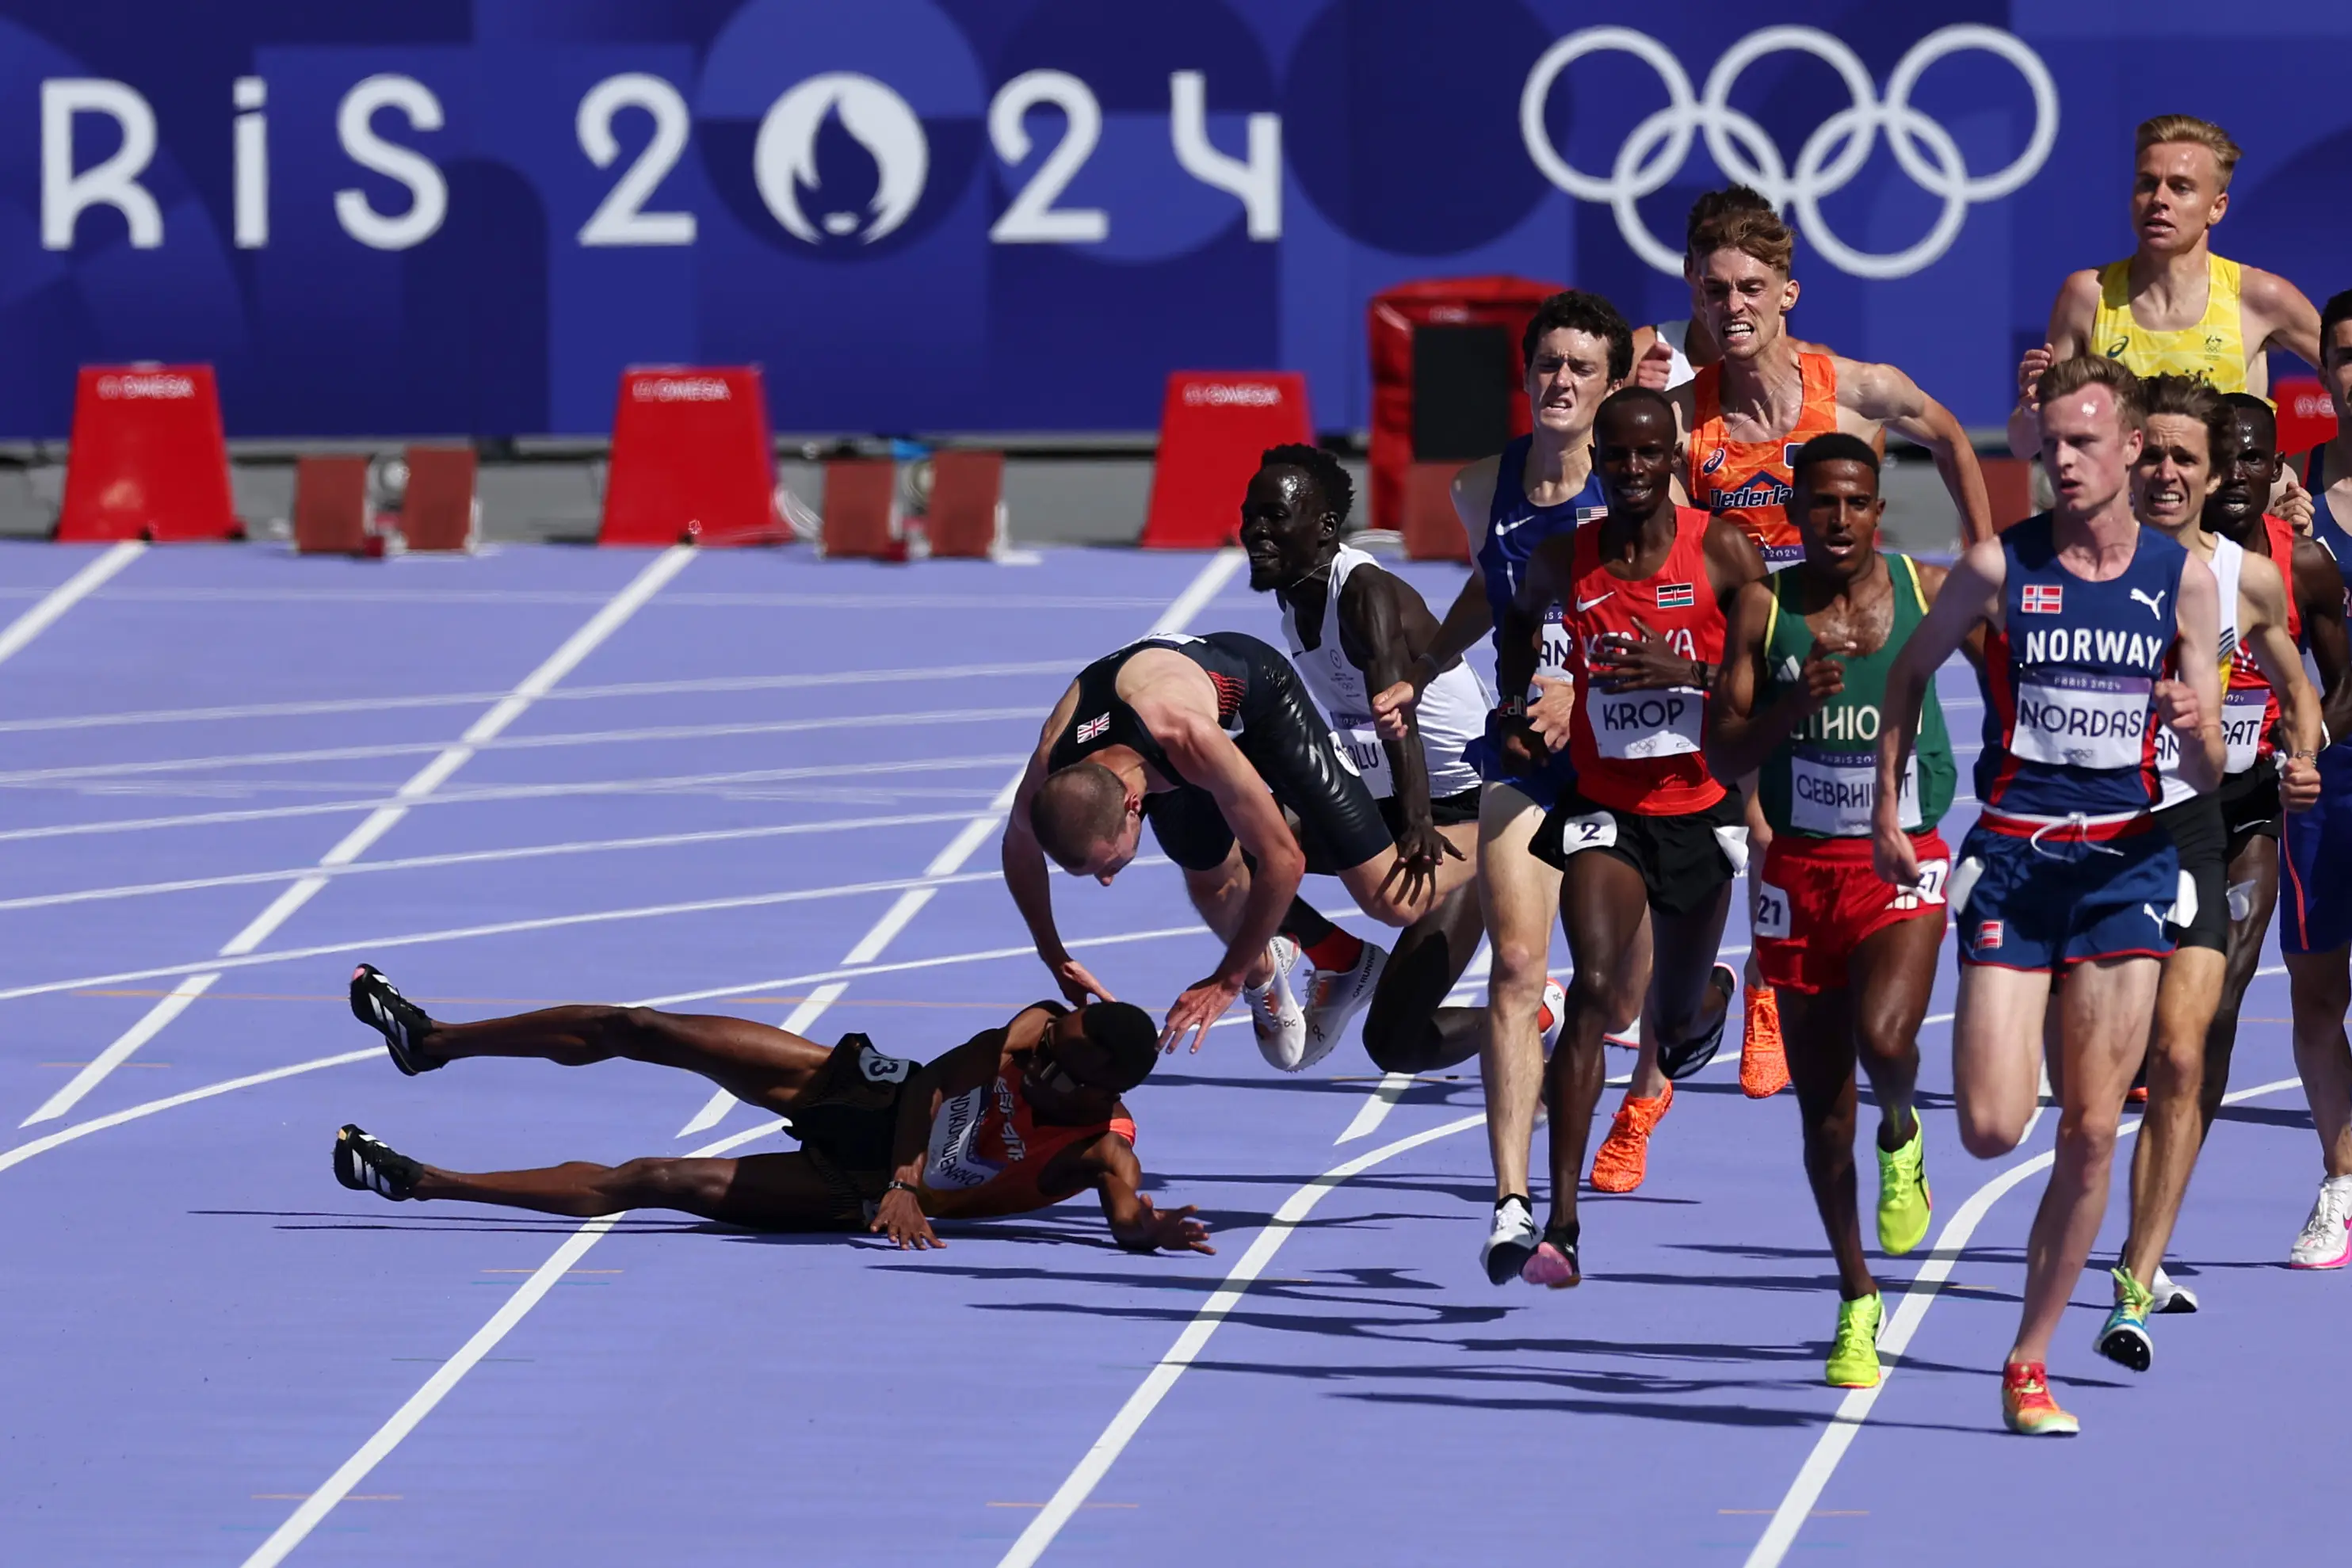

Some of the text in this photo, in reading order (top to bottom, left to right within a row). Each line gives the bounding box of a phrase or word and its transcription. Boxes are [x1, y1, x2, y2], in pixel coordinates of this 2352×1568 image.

[1709, 484, 1793, 508] Nederla
[2026, 628, 2163, 671] NORWAY
[1602, 698, 1686, 731] KROP
[2020, 698, 2142, 738] NORDAS
[1796, 772, 1912, 809] GEBRHIT
[1579, 822, 1602, 842] 2
[1758, 894, 1781, 926] 21
